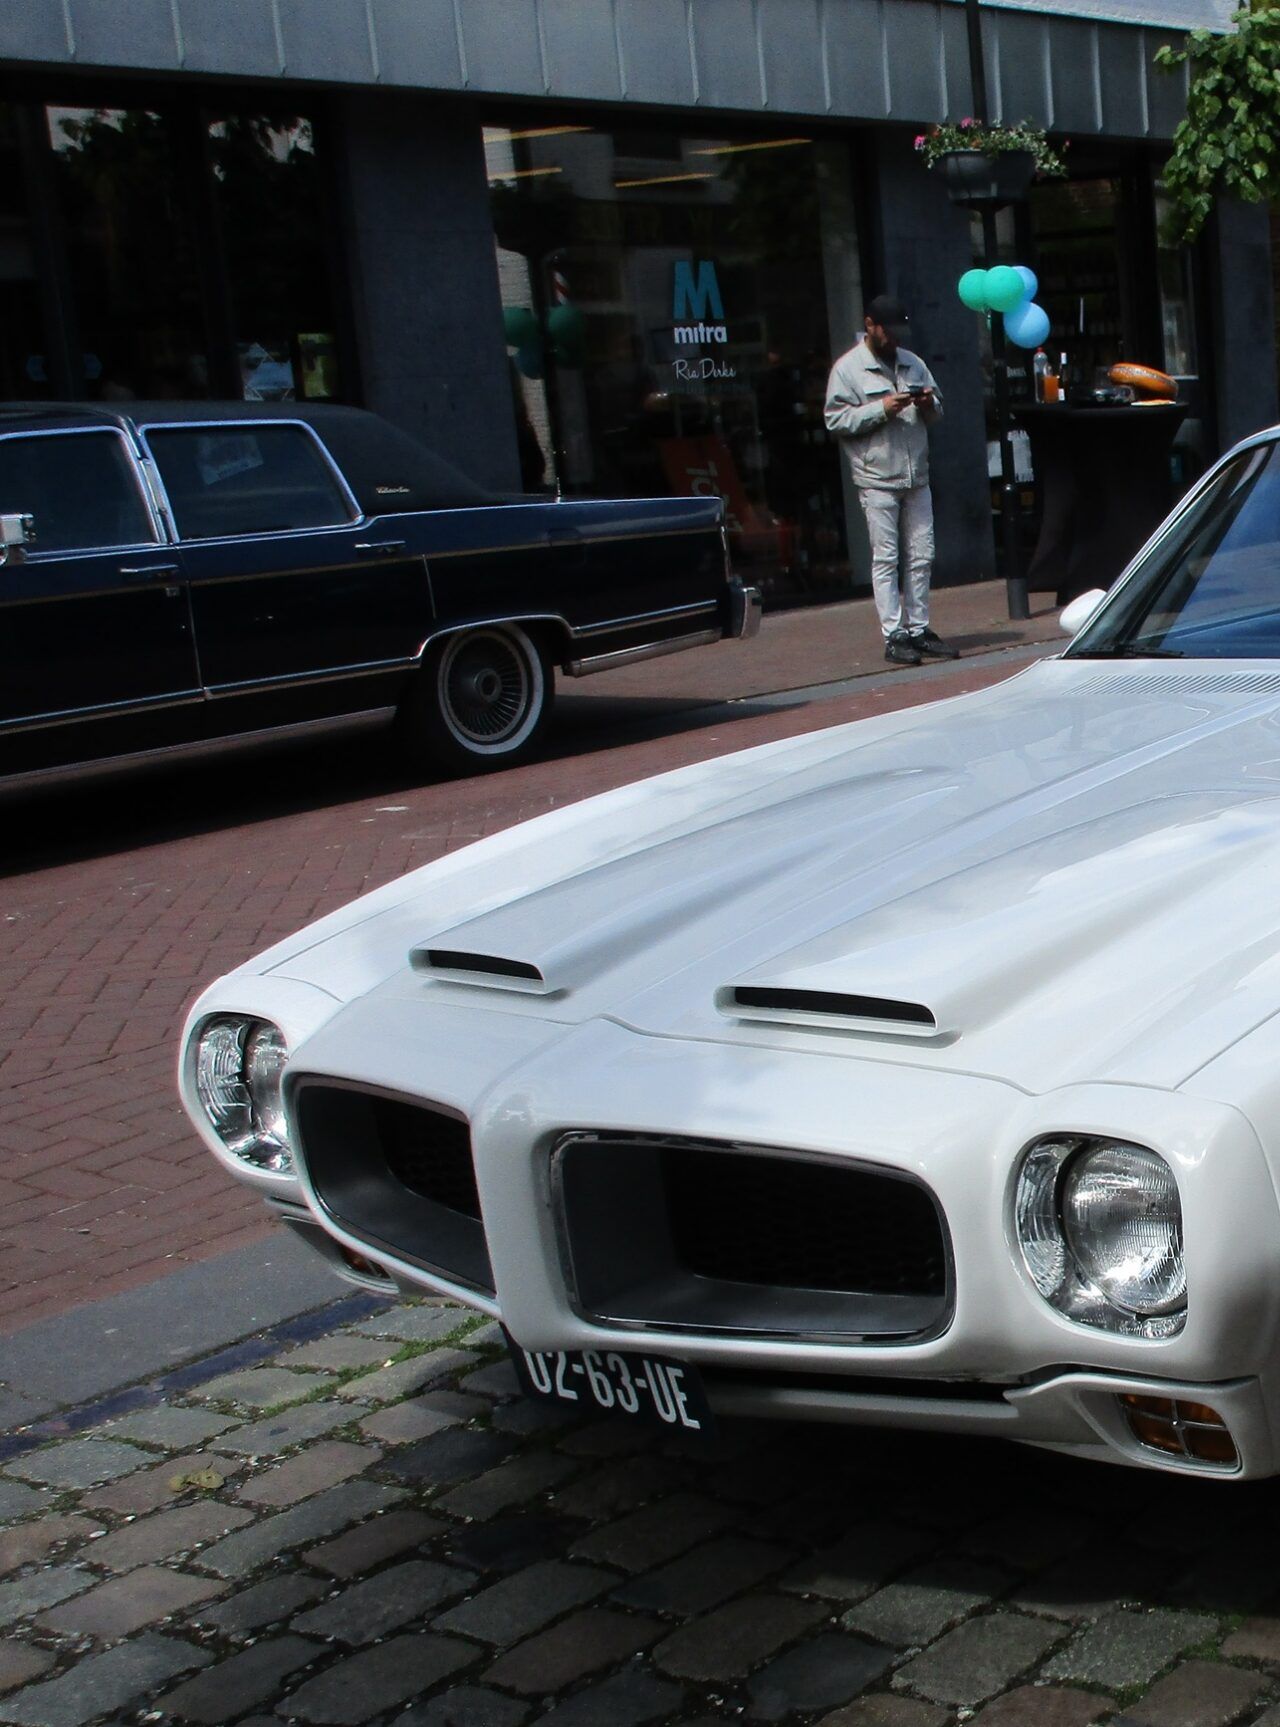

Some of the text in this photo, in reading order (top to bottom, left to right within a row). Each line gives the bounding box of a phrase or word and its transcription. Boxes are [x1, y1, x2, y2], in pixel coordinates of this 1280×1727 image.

[673, 260, 725, 320] M
[673, 322, 728, 344] mitra
[671, 359, 699, 381] Ria
